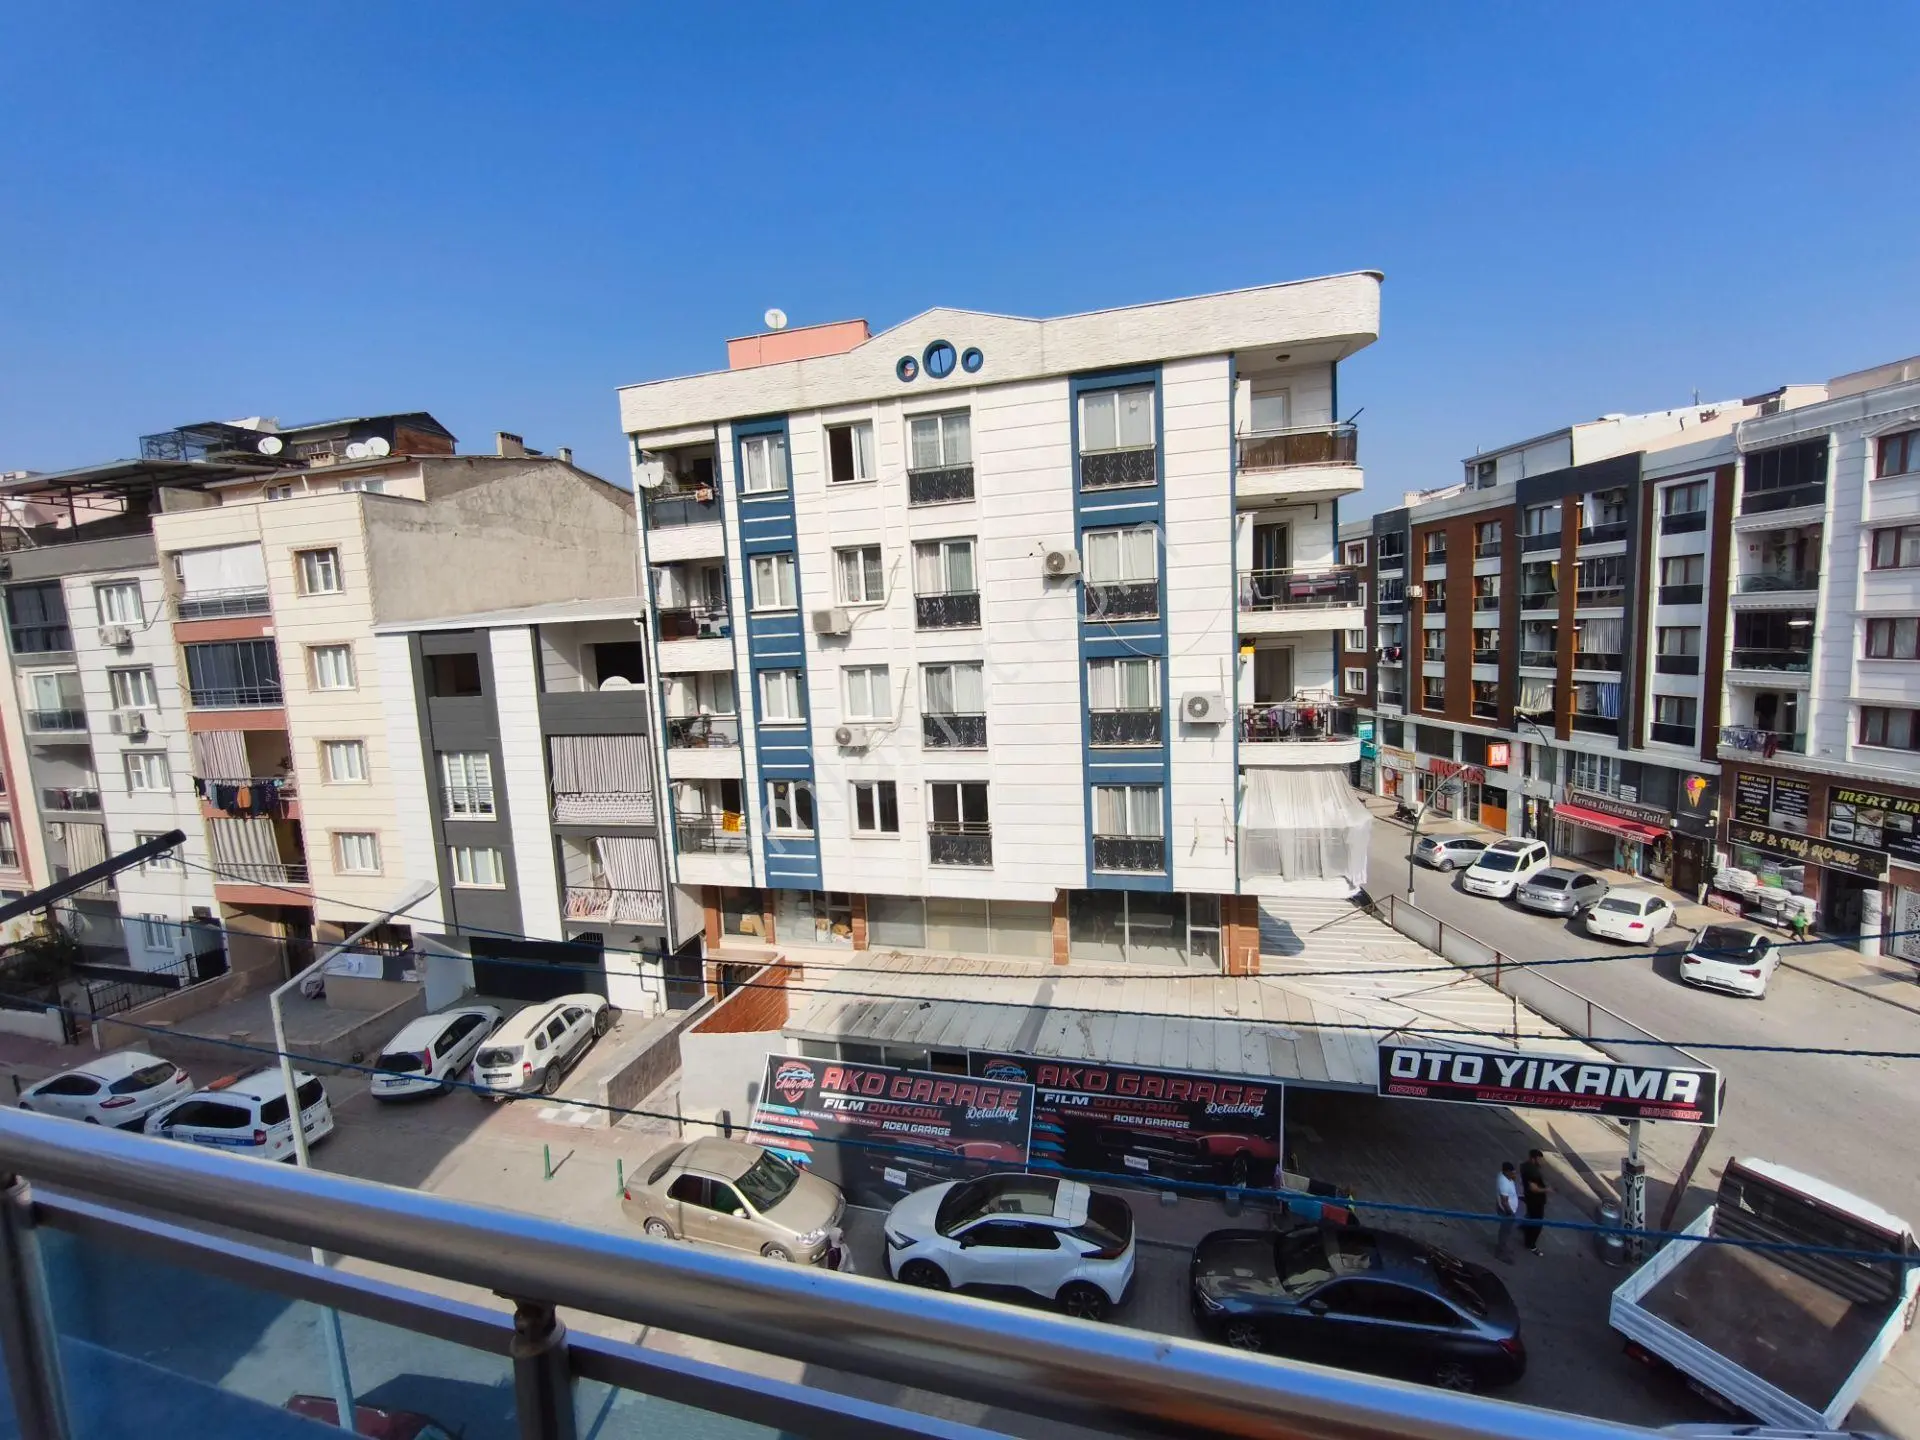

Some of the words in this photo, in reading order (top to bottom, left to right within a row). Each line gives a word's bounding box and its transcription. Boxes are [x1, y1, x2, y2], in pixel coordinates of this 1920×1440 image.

[1389, 1049, 1484, 1085] OTO
[1494, 1057, 1701, 1104] YIKAMA
[889, 1075, 1022, 1109] GARAGE
[1115, 1073, 1268, 1107] GARAGE
[823, 1098, 865, 1111] FILM
[1044, 1093, 1090, 1106] FILM
[965, 1105, 1019, 1121] Detailing
[1204, 1102, 1266, 1118] Detailing
[910, 1123, 952, 1137] GARAGE
[1145, 1117, 1191, 1129] GARAGE
